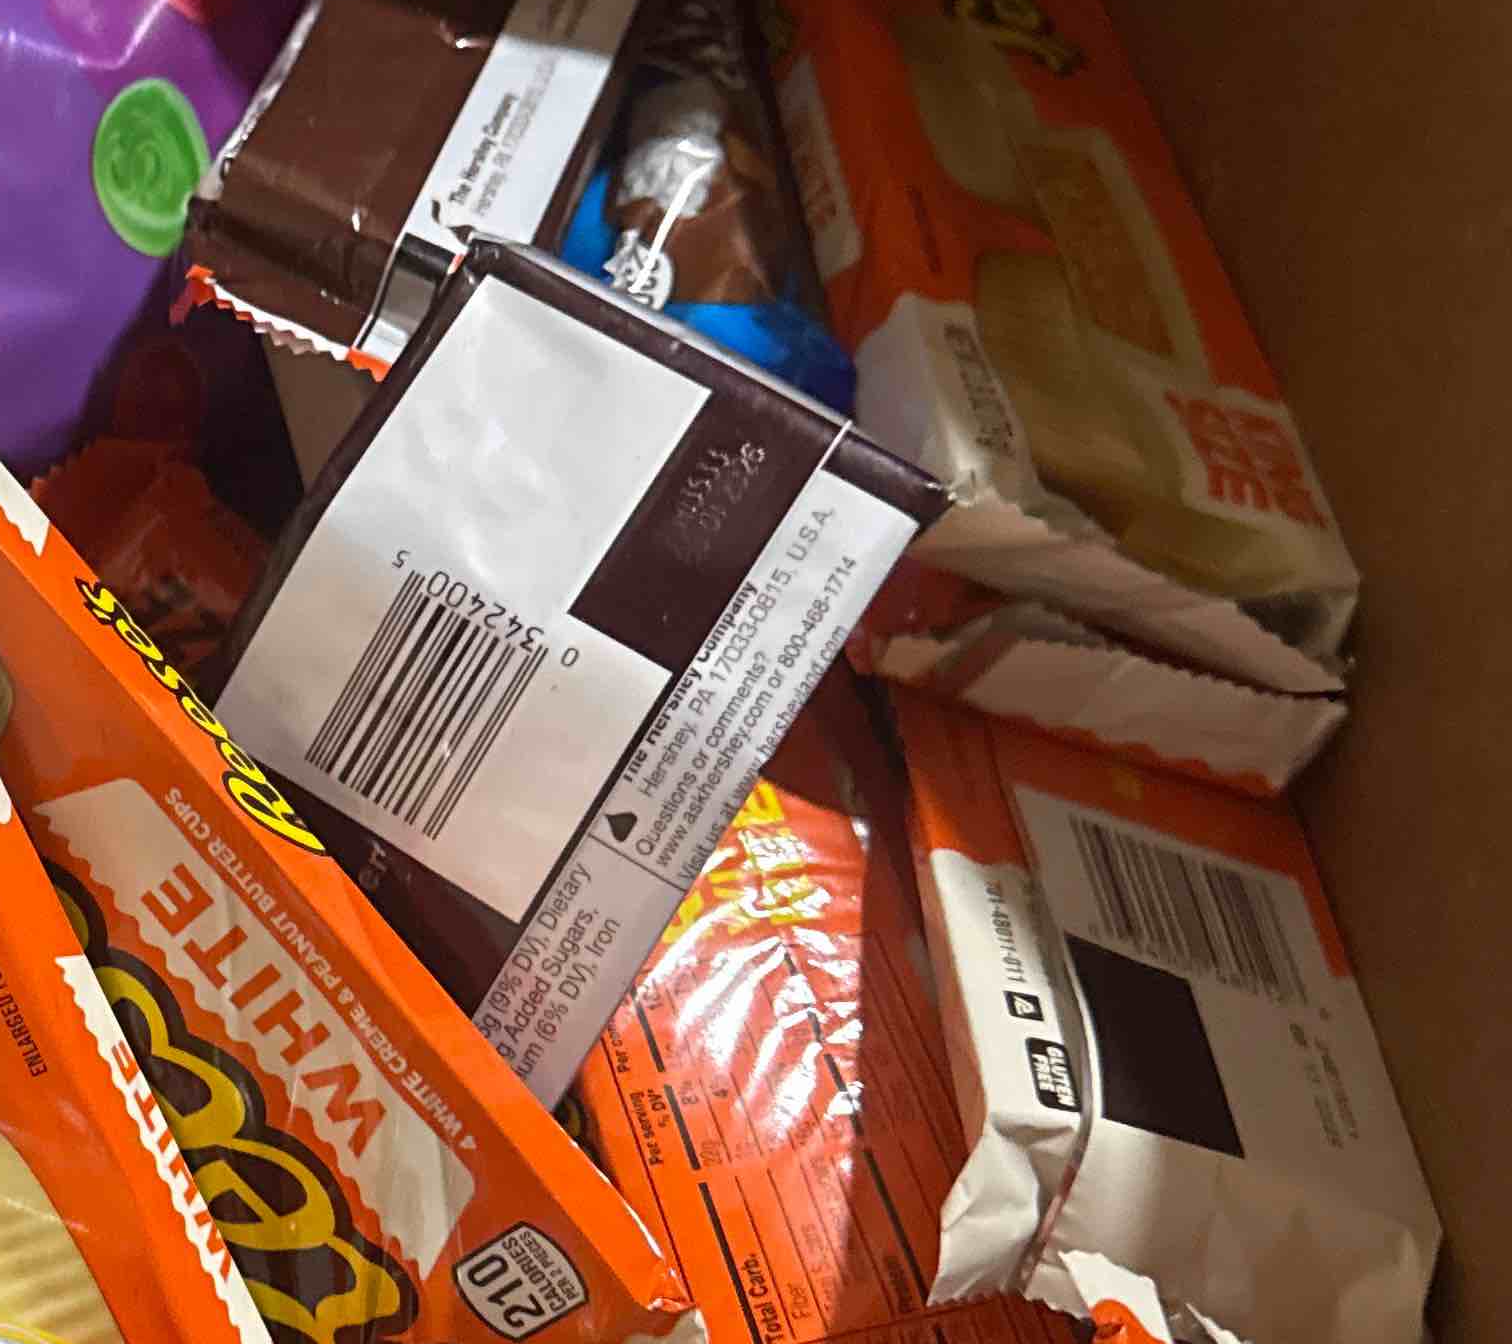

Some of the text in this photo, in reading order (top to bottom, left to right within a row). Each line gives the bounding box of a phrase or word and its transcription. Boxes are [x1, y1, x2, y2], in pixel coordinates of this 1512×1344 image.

[387, 544, 582, 670] 0 342400 5
[686, 683, 718, 718] PA
[784, 500, 835, 565] U.S.A.
[773, 550, 861, 672] 800-468-1714
[74, 575, 326, 856] Reese's
[698, 647, 774, 751] comments?
[763, 665, 789, 692] or
[688, 744, 714, 773] or
[630, 766, 701, 861] Questions
[674, 797, 739, 885] Visit us at
[158, 783, 482, 1157] 4 WHITE CREME PEANUT BUTTER CUPS
[483, 967, 526, 1016] (9%
[534, 858, 596, 936] Dietary
[499, 899, 603, 1042] Added Sugars,
[530, 996, 571, 1044] (6%
[581, 912, 622, 959] Iron
[128, 858, 411, 1161] WHITE
[610, 1047, 631, 1074] Per
[1031, 1049, 1056, 1094] FREE
[1045, 1042, 1076, 1109] GLUTEN
[626, 1088, 666, 1167] Per serving
[462, 1244, 546, 1339] 210
[499, 1227, 568, 1321] CALORIES
[518, 1225, 555, 1273] PIECES
[553, 1272, 579, 1302] PER
[736, 1249, 771, 1299] Carb.
